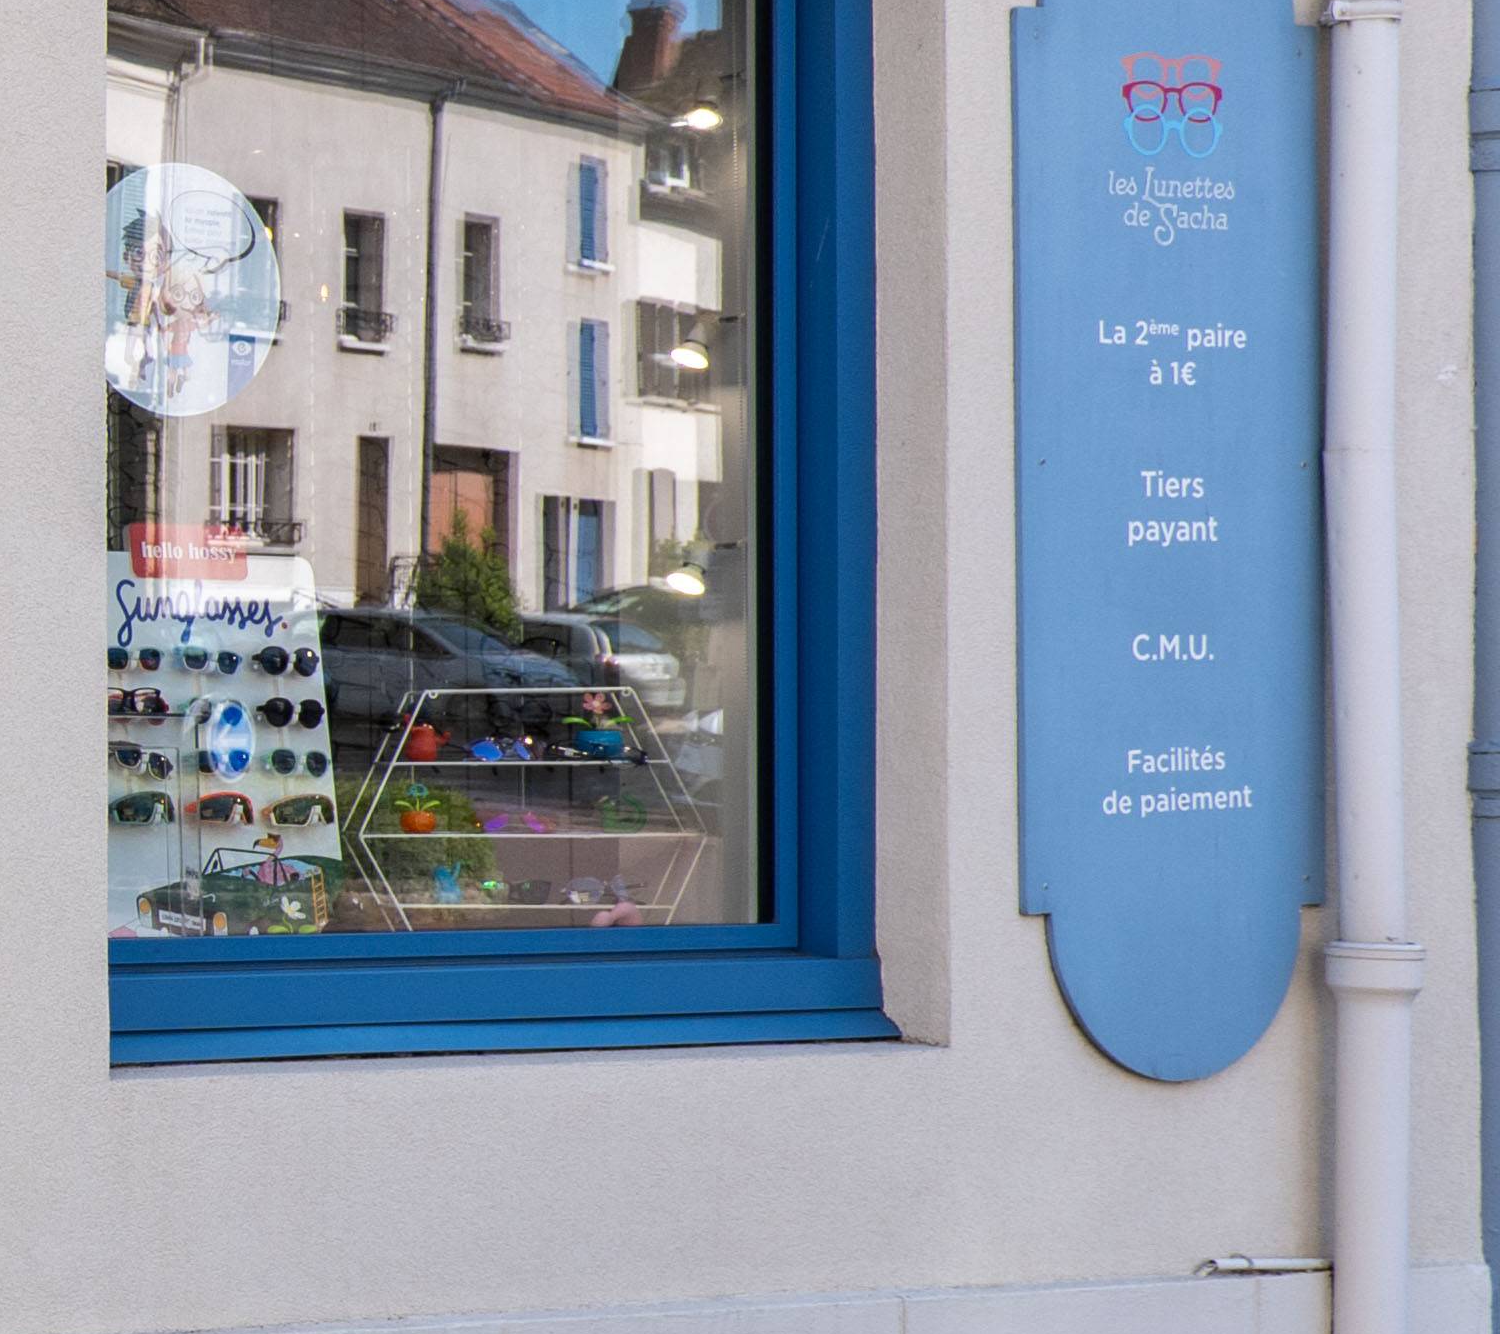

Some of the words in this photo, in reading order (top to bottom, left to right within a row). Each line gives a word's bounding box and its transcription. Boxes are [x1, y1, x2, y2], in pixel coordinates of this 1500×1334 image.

[1108, 171, 1137, 195] les
[1141, 166, 1235, 208] Lunettes
[1124, 203, 1150, 228] de
[1154, 204, 1228, 246] Sacha
[1099, 320, 1126, 346] La
[1135, 319, 1179, 346] 2ème
[1186, 323, 1246, 351] paire
[1149, 359, 1162, 385] à
[1170, 361, 1197, 385] 1€
[1141, 470, 1204, 498] Tiers
[1128, 516, 1218, 546] payant
[141, 541, 183, 559] hello
[188, 543, 236, 563] hossy
[1132, 634, 1214, 661] C.M.U.
[1127, 745, 1226, 773] Facilités
[1102, 790, 1132, 815] de
[1140, 785, 1252, 817] paiement
